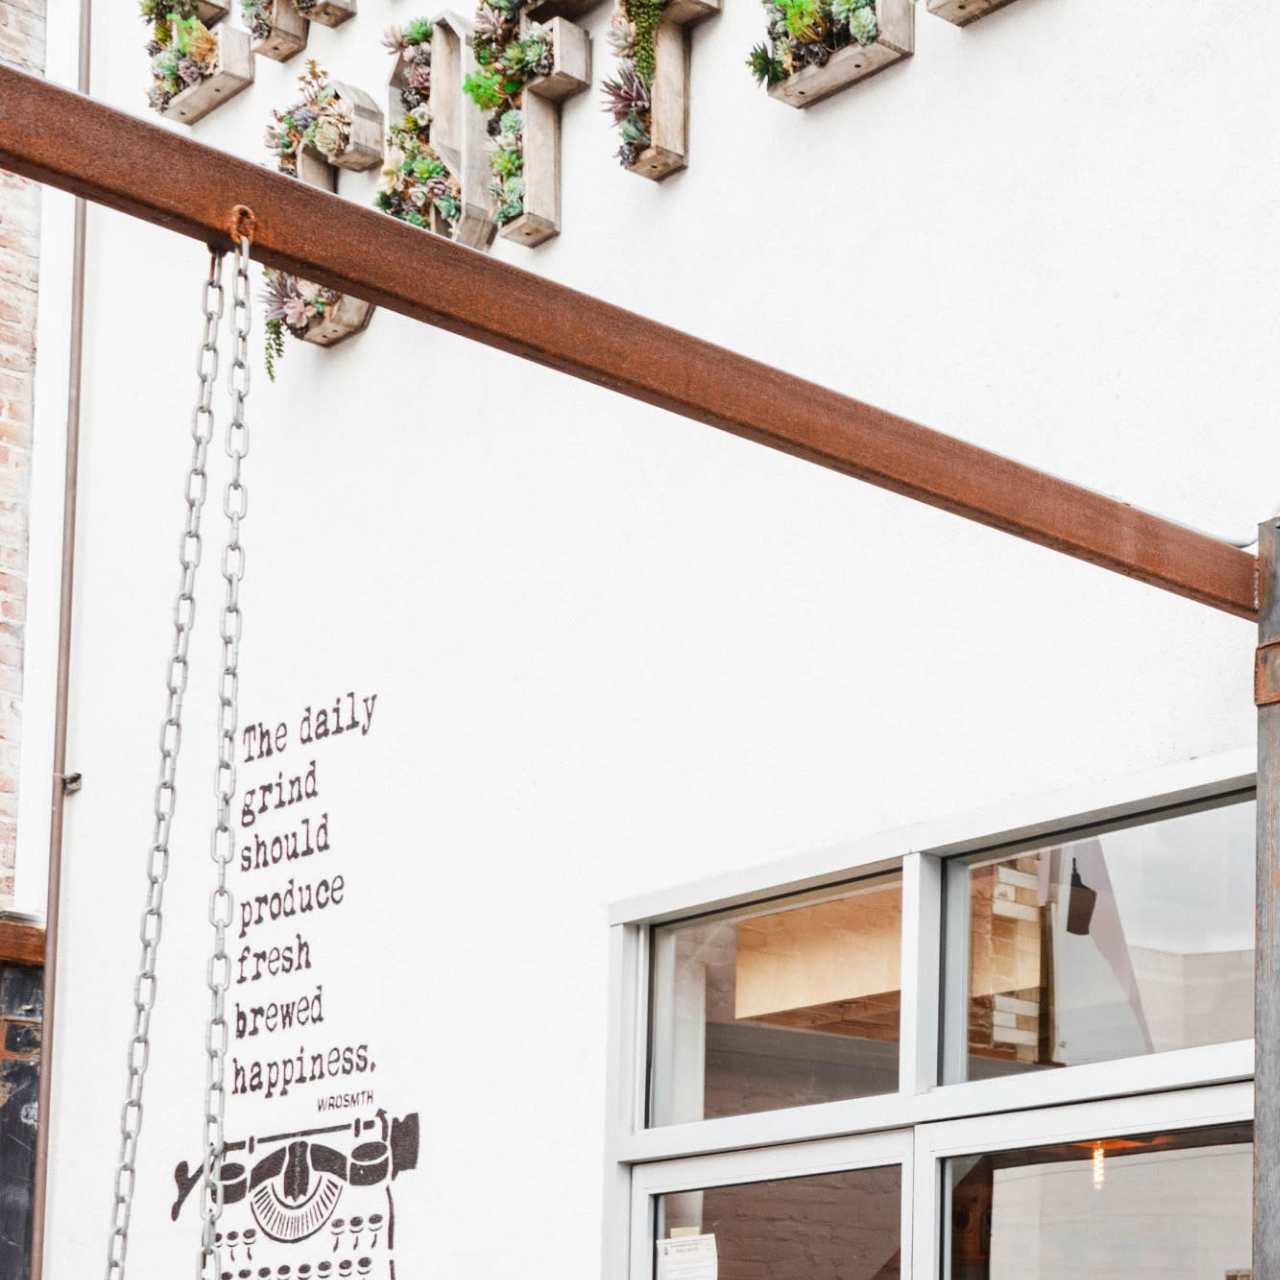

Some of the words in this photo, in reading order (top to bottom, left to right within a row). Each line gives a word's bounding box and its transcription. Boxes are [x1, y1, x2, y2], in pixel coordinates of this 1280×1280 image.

[243, 721, 288, 763] The
[299, 691, 377, 745] daily
[240, 760, 319, 828] grind
[240, 812, 331, 872] should
[238, 874, 345, 939] produce
[235, 933, 312, 985] fresh
[234, 985, 325, 1040] brewed
[231, 1044, 377, 1100] happiness.
